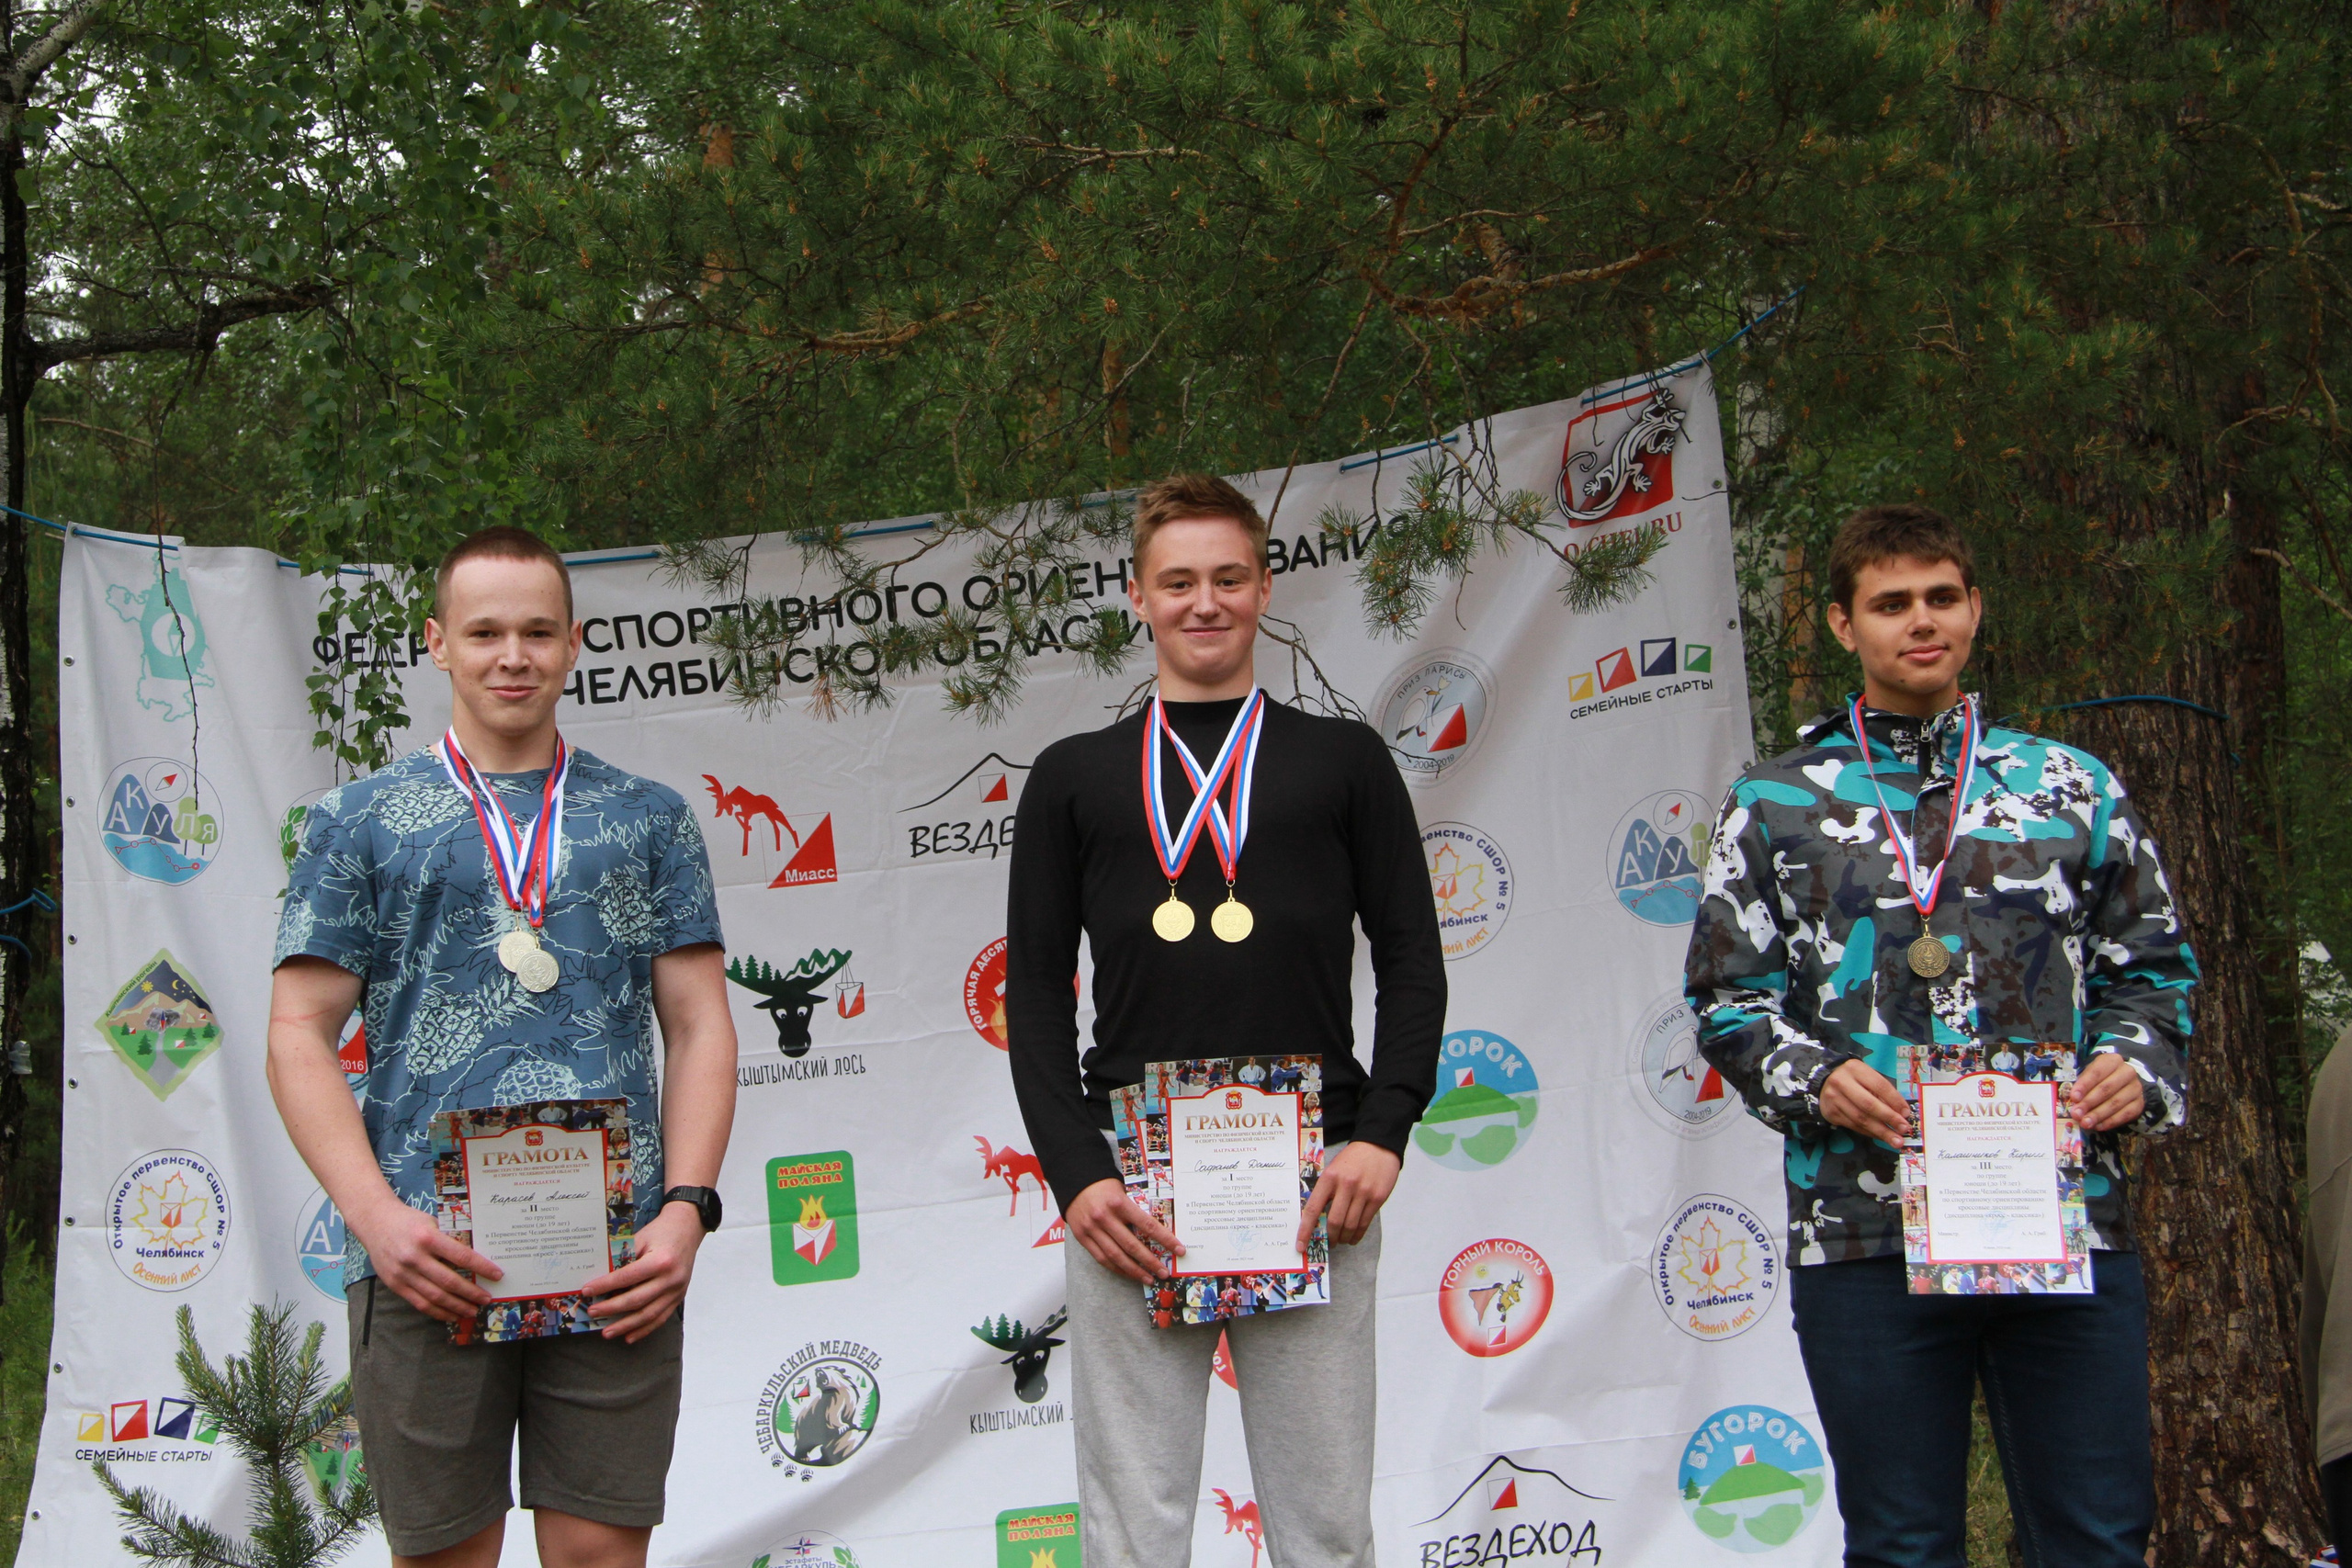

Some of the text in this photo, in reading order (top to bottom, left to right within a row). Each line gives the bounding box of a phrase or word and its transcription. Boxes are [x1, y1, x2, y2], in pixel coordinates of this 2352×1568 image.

[1397, 665, 1466, 699] ПРИЗ ЛАРИСЫ
[1570, 679, 1713, 719] СЕМЕЙНЫЕ СТАРТЫ
[909, 815, 1014, 861] ВЕЗДЕ
[1620, 826, 1707, 886] АКУЛ
[785, 866, 835, 884] Миасс
[1420, 829, 1473, 843] венство
[1476, 839, 1506, 874] СШОР
[1496, 902, 1506, 910] 5
[1440, 914, 1488, 929] ябинск
[967, 939, 1008, 1031] ГОРЯЧАЯ ДЕСЯТ
[1656, 1009, 1685, 1034] ПРИЗ
[340, 1059, 364, 1071] 2016
[1439, 1036, 1522, 1078] ОРОК
[736, 1054, 866, 1088] КЫШТЫМСКИЙ ЛОСЬ
[1185, 1111, 1283, 1131] ГРАМОТА
[1937, 1101, 2039, 1118] ГРАМОТА
[131, 1156, 205, 1180] первенство
[482, 1147, 589, 1166] ГРАМОТА
[777, 1160, 842, 1177] МАЙСКАЯ
[1979, 1161, 1991, 1170] III
[778, 1172, 842, 1190] ПОЛЯНА
[1229, 1173, 1233, 1181] I
[207, 1172, 225, 1213] СШОР
[113, 1181, 131, 1249] Открытое
[530, 1204, 537, 1213] II
[136, 1247, 205, 1258] Челябинск
[212, 1240, 220, 1250] 5
[1658, 1235, 1674, 1305] Открытое
[1673, 1201, 1734, 1233] первенство
[1737, 1213, 1770, 1252] СШОР
[1762, 1280, 1772, 1290] 5
[1443, 1240, 1544, 1289] ГОРНЫЙ КОРОЛЬ
[1687, 1292, 1755, 1310] Челябинск
[756, 1339, 882, 1454] ЧЕБАРКУЛЬСКИЙ МЕДВЕДЬ
[969, 1404, 1064, 1434] КЫШТЫМСКИЙ
[1687, 1411, 1806, 1470] БУГОРОК
[75, 1447, 213, 1462] СЕМЕЙНЫЕ СТАРТЫ
[1007, 1513, 1075, 1529] МАЙСКАЯ
[1007, 1525, 1076, 1541] ПОЛЯНА
[1419, 1519, 1602, 1568] ВЕЗДЕХОД
